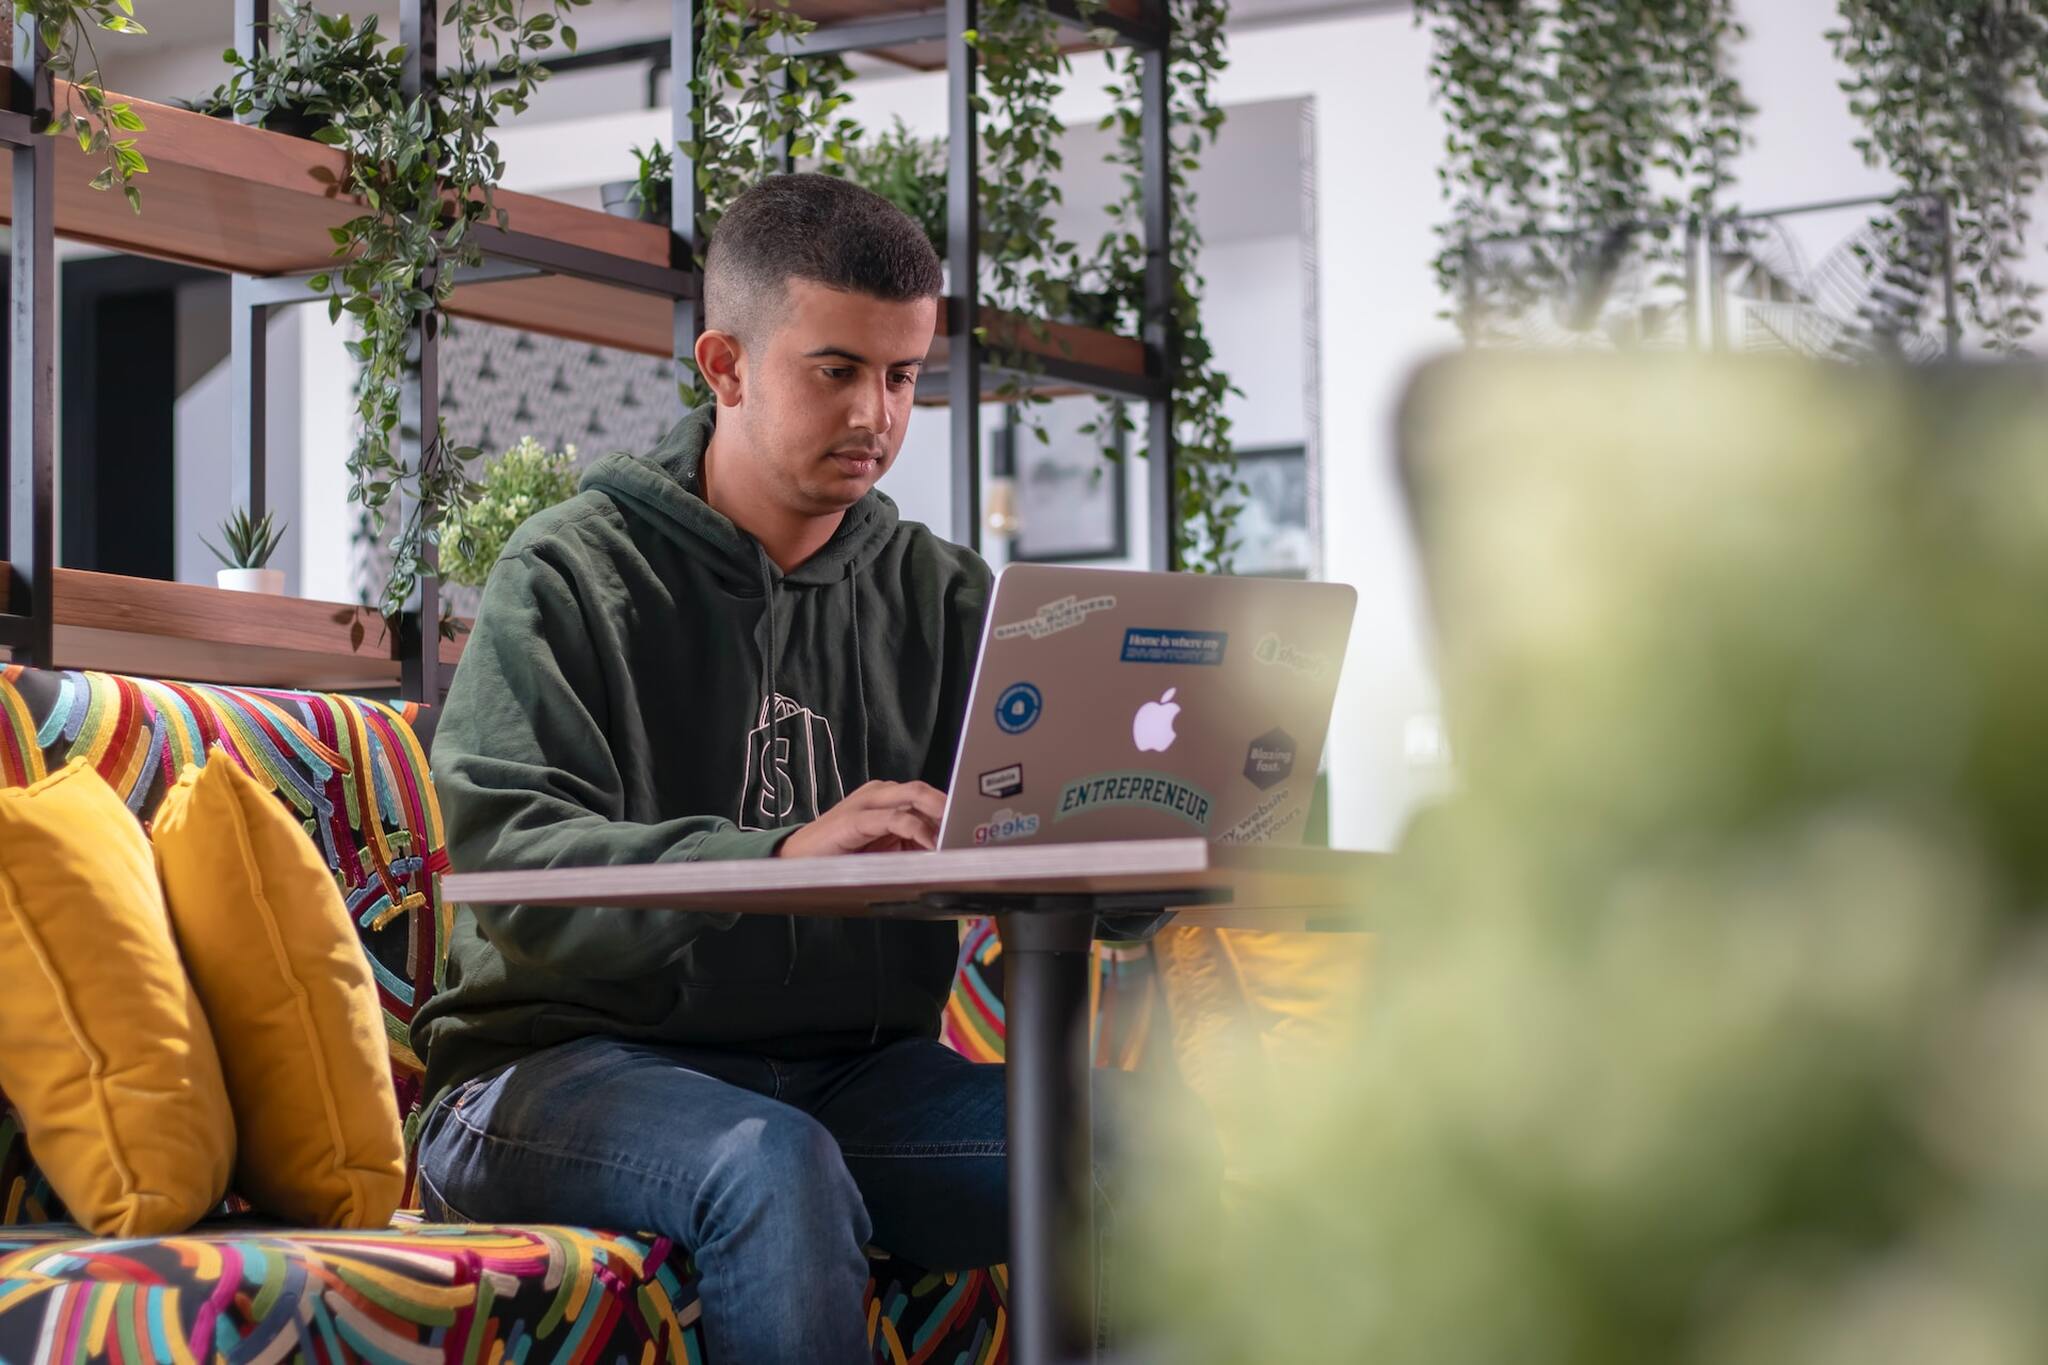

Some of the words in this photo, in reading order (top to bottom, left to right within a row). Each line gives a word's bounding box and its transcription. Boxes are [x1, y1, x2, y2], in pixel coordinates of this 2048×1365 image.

[997, 621, 1042, 636] SMALL
[1046, 599, 1113, 623] BUSINESS
[1128, 634, 1159, 647] Home
[1161, 634, 1169, 647] is
[1171, 636, 1201, 649] where
[1203, 639, 1218, 651] my
[1251, 748, 1292, 763] Blazing
[1062, 777, 1209, 824] ENTREPRENEUR
[1239, 790, 1288, 829] website
[975, 815, 1037, 845] geeks
